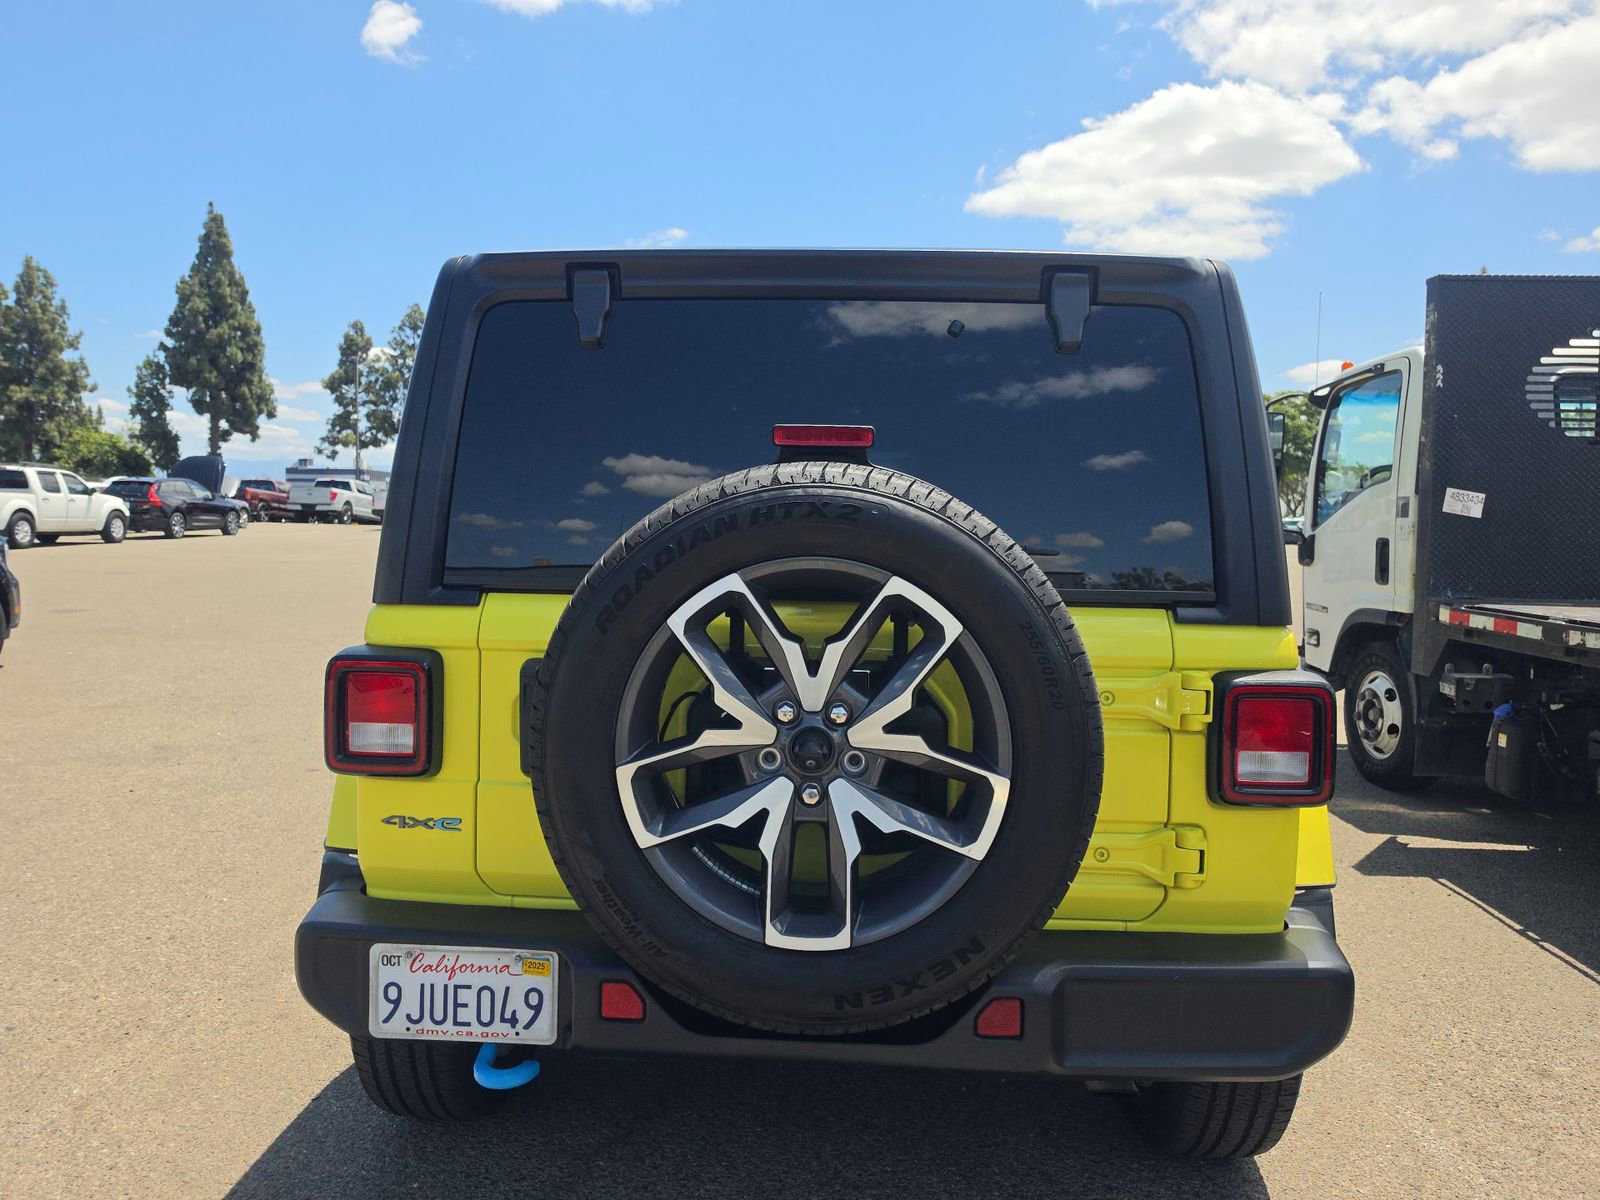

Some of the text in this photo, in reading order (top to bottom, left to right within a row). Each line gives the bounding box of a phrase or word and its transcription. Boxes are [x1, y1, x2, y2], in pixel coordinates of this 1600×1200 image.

[594, 500, 861, 635] ROADIAN HTX2
[381, 952, 523, 981] OCT California
[527, 961, 546, 971] 2025
[834, 937, 987, 1011] NEXEN
[381, 981, 544, 1031] 9JUE049
[415, 1027, 510, 1039] dmv.ca.gov
